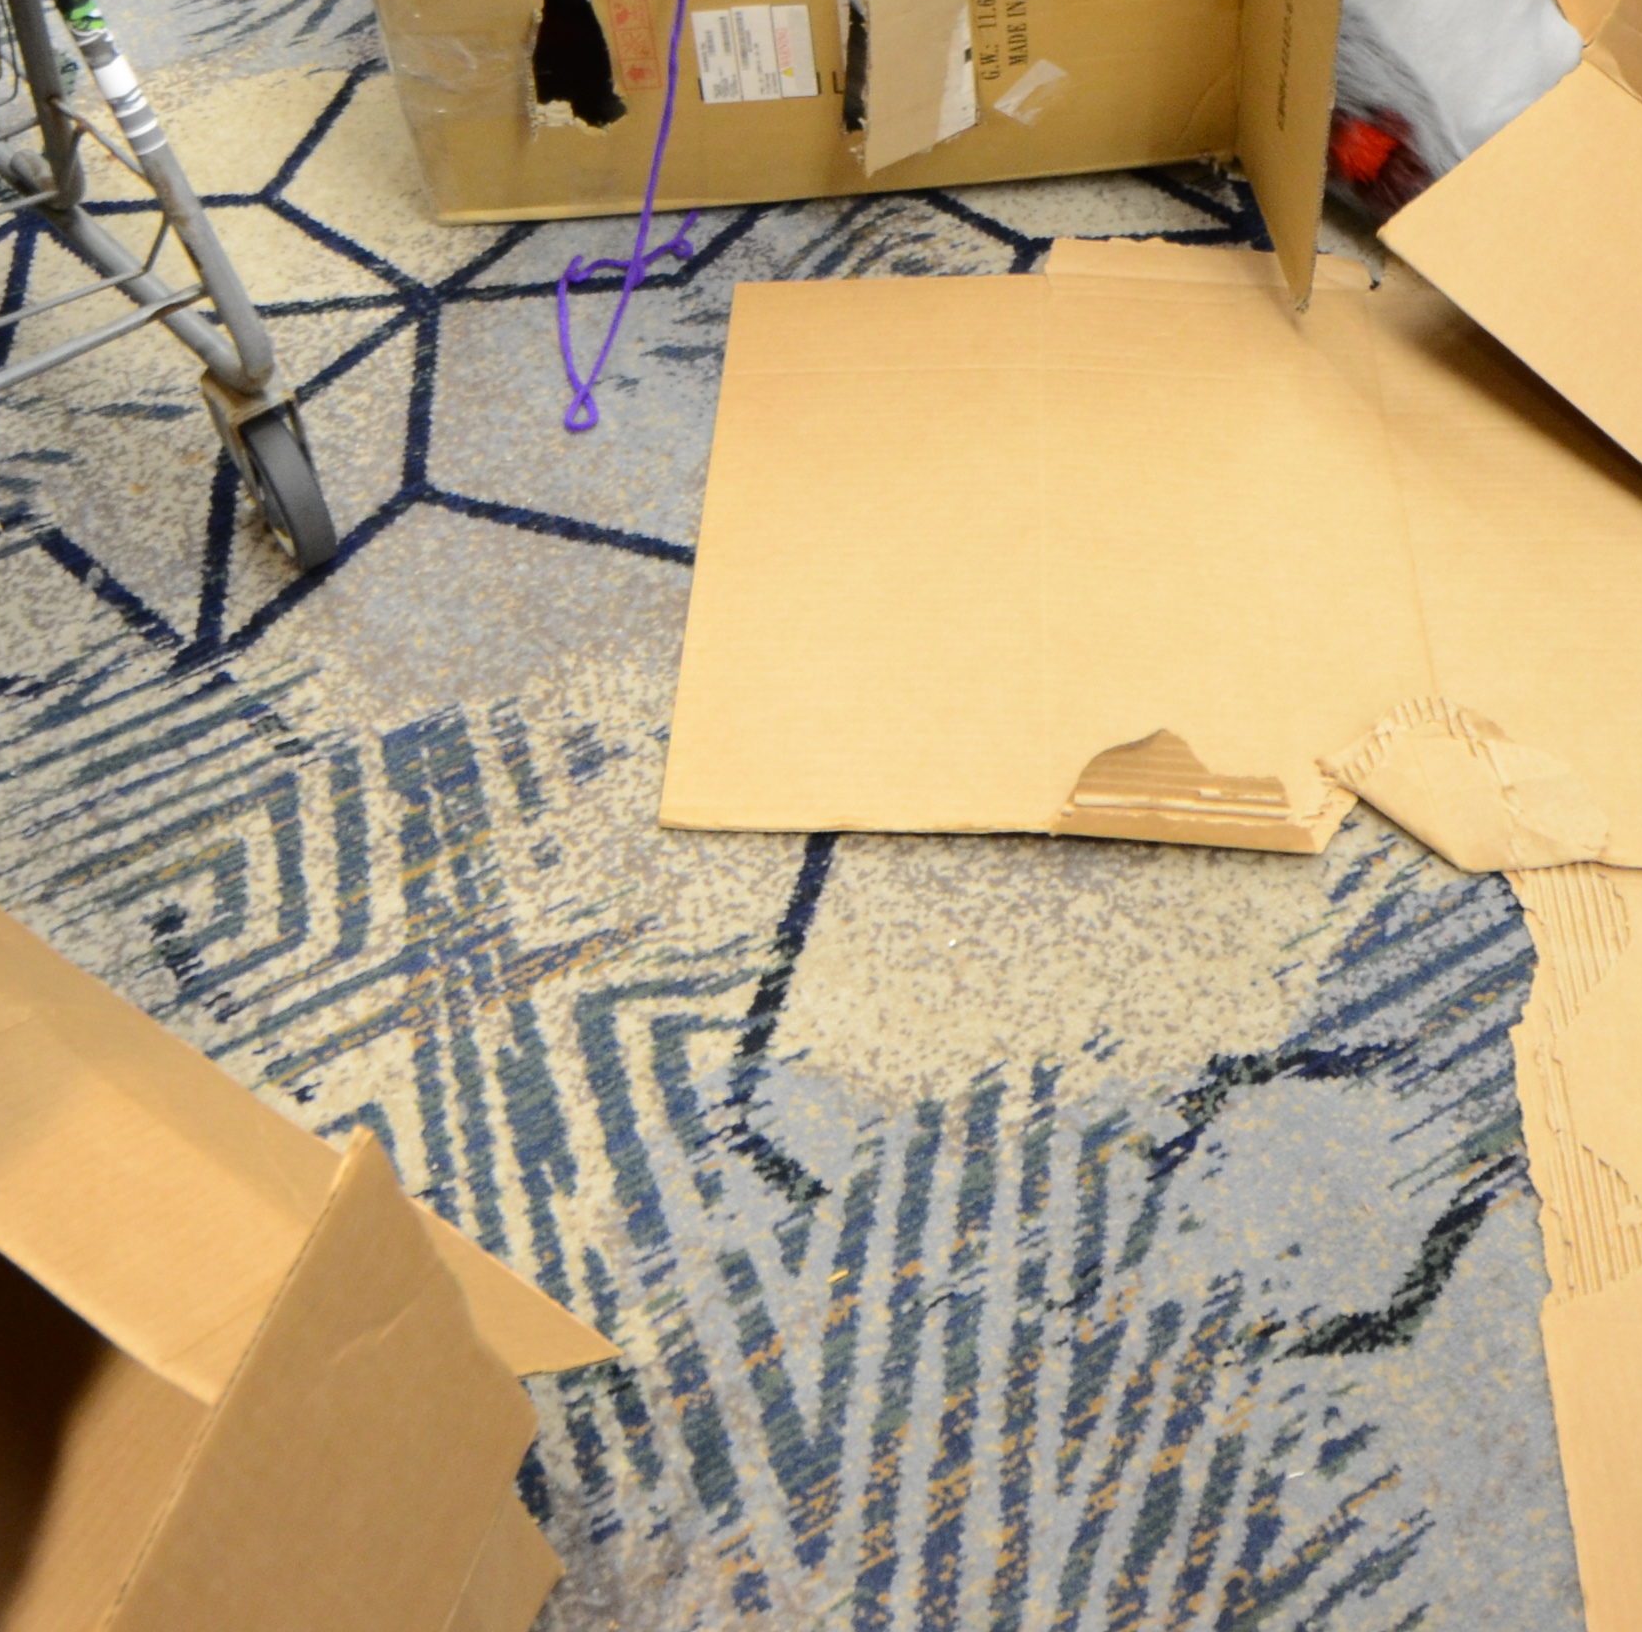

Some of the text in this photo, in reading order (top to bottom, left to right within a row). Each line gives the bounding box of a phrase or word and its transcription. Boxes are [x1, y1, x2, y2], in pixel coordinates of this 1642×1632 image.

[1006, 0, 1027, 19] IN
[979, 45, 1001, 81] G.W.:
[1007, 23, 1029, 67] MADE
